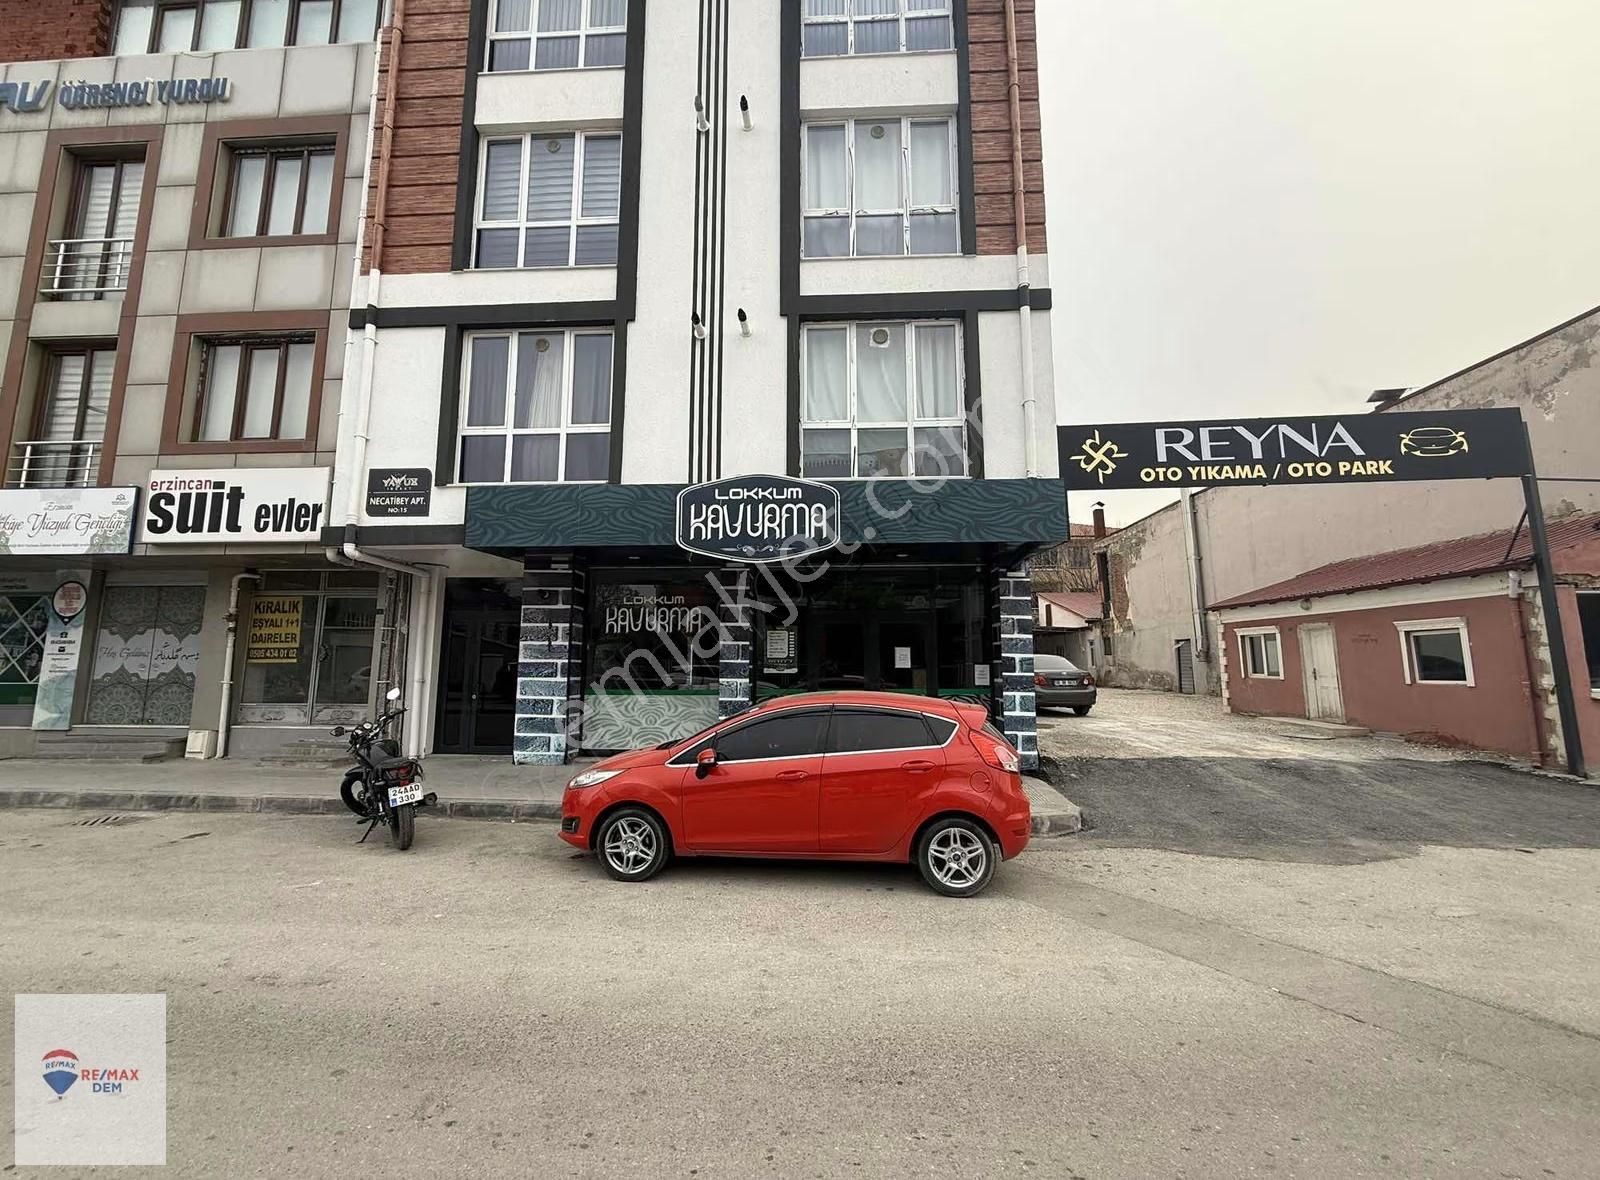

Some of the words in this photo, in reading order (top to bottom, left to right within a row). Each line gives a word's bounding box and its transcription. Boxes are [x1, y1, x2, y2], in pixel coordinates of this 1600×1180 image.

[157, 77, 231, 105] YURDU
[1155, 422, 1366, 462] REYNA
[1140, 467, 1182, 482] OTO
[1187, 464, 1267, 480] YIKAMA
[1287, 462, 1332, 477] OTO
[1338, 460, 1395, 476] PARK
[150, 477, 212, 491] erzincan
[369, 496, 409, 505] NECATİBEY
[410, 497, 426, 505] APT.
[714, 487, 803, 500] LOKKUM
[147, 481, 245, 534] suit
[254, 497, 322, 533] evler
[689, 502, 828, 541] KAVURMA
[623, 595, 685, 605] LOKKUM
[252, 618, 283, 630] EŞYALI
[286, 618, 299, 628] 1+1
[605, 607, 702, 634] KAVURMA
[399, 794, 415, 803] 330
